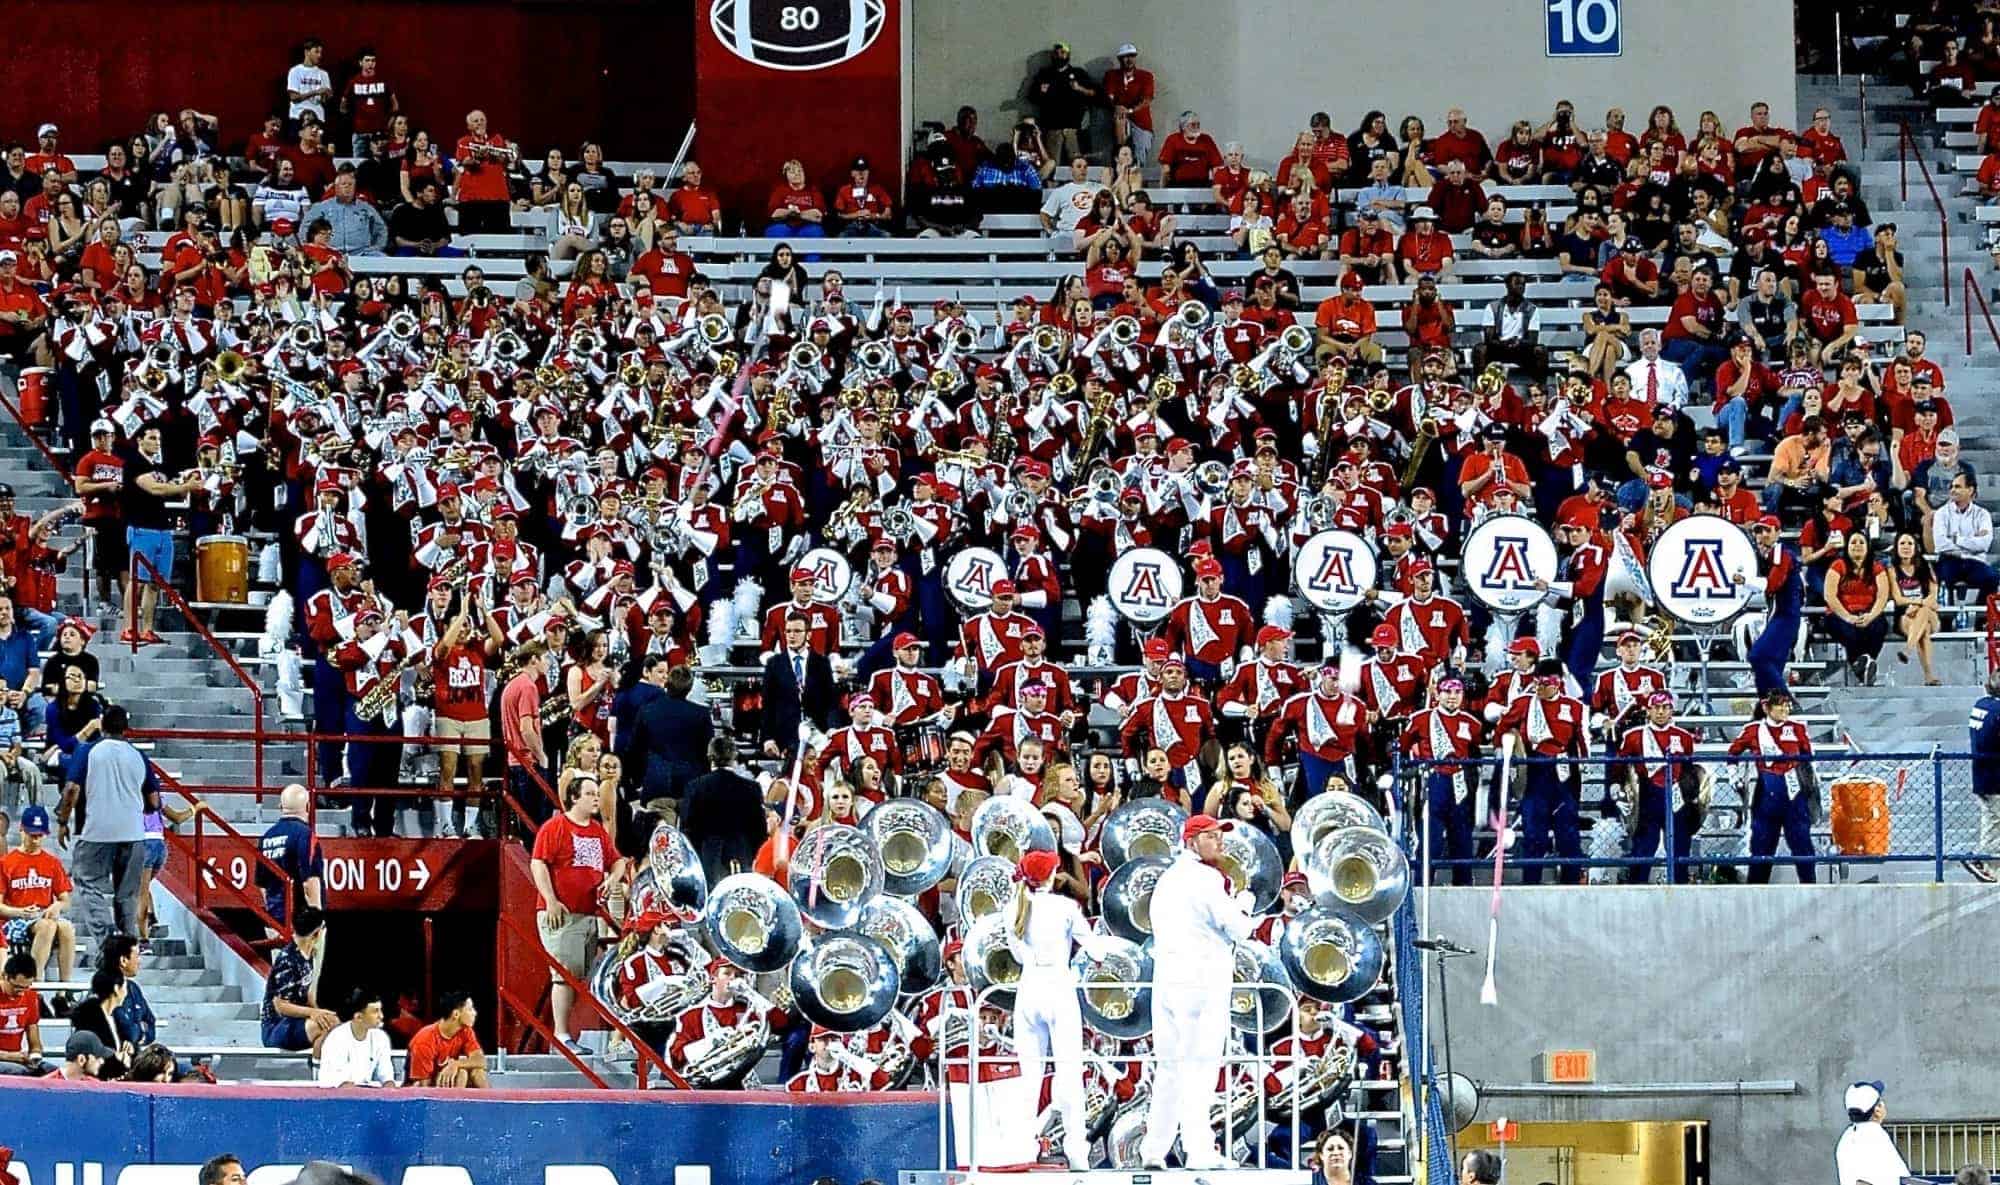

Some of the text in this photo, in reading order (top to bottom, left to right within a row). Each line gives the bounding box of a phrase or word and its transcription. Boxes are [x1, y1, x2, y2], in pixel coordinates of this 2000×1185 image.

[781, 6, 819, 30] 80
[1550, 0, 1617, 43] 10
[813, 557, 839, 594] A
[956, 557, 994, 597] A
[1308, 546, 1359, 595] A
[1481, 536, 1540, 590] A
[1671, 538, 1736, 598] A
[1121, 562, 1167, 606] A
[231, 857, 247, 890] 9
[375, 858, 402, 891] 10
[1555, 1055, 1587, 1078] EXIT
